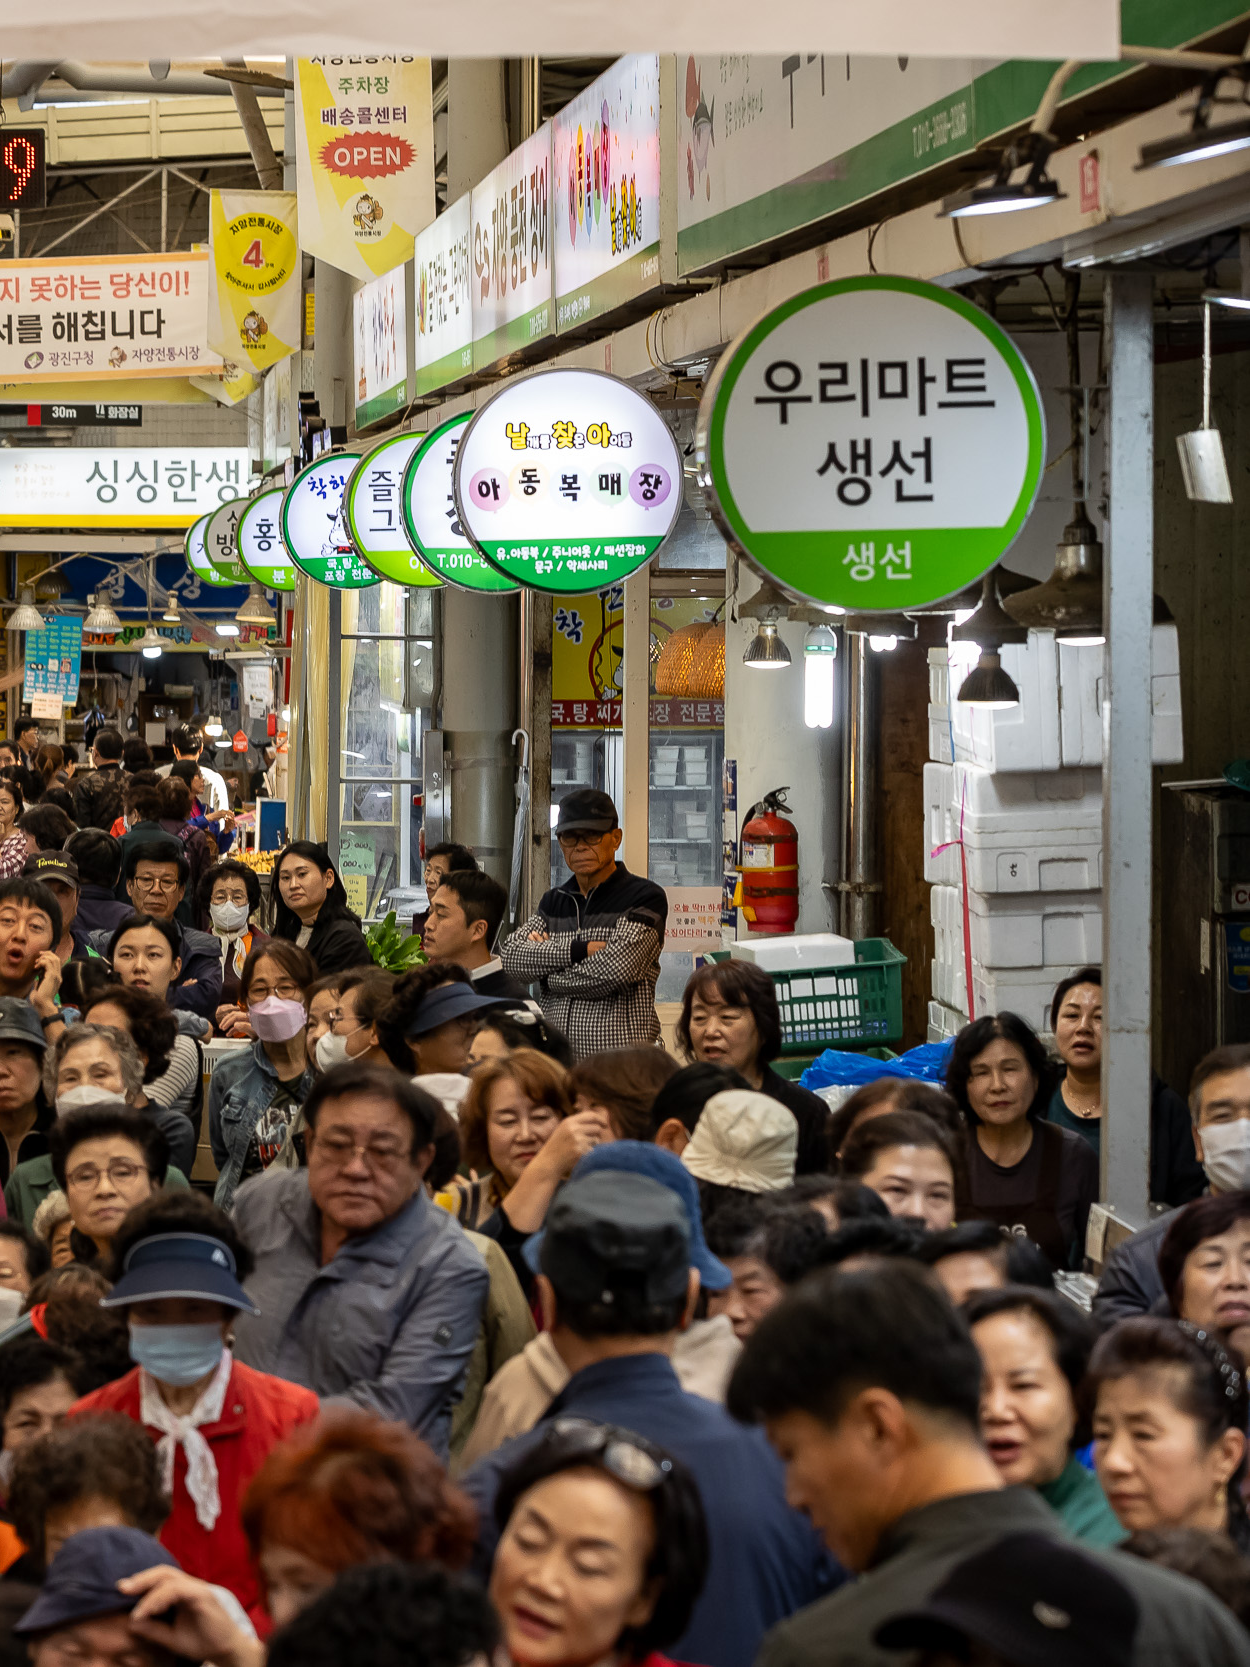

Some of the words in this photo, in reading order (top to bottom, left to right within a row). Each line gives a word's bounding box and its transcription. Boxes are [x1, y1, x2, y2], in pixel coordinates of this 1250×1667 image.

[338, 77, 390, 95] 주차장
[321, 106, 408, 126] 배송콜센터
[334, 147, 401, 167] OPEN
[243, 240, 264, 269] 4
[29, 273, 102, 302] 못하는
[109, 270, 190, 299] 당신이!
[51, 307, 166, 343] 해칩니다
[48, 350, 94, 367] 광진구청
[131, 345, 200, 362] 자양전통시장
[753, 356, 996, 425] 우리마트
[52, 406, 77, 419] 30m
[816, 436, 934, 507] 생선
[842, 540, 913, 582] 생선
